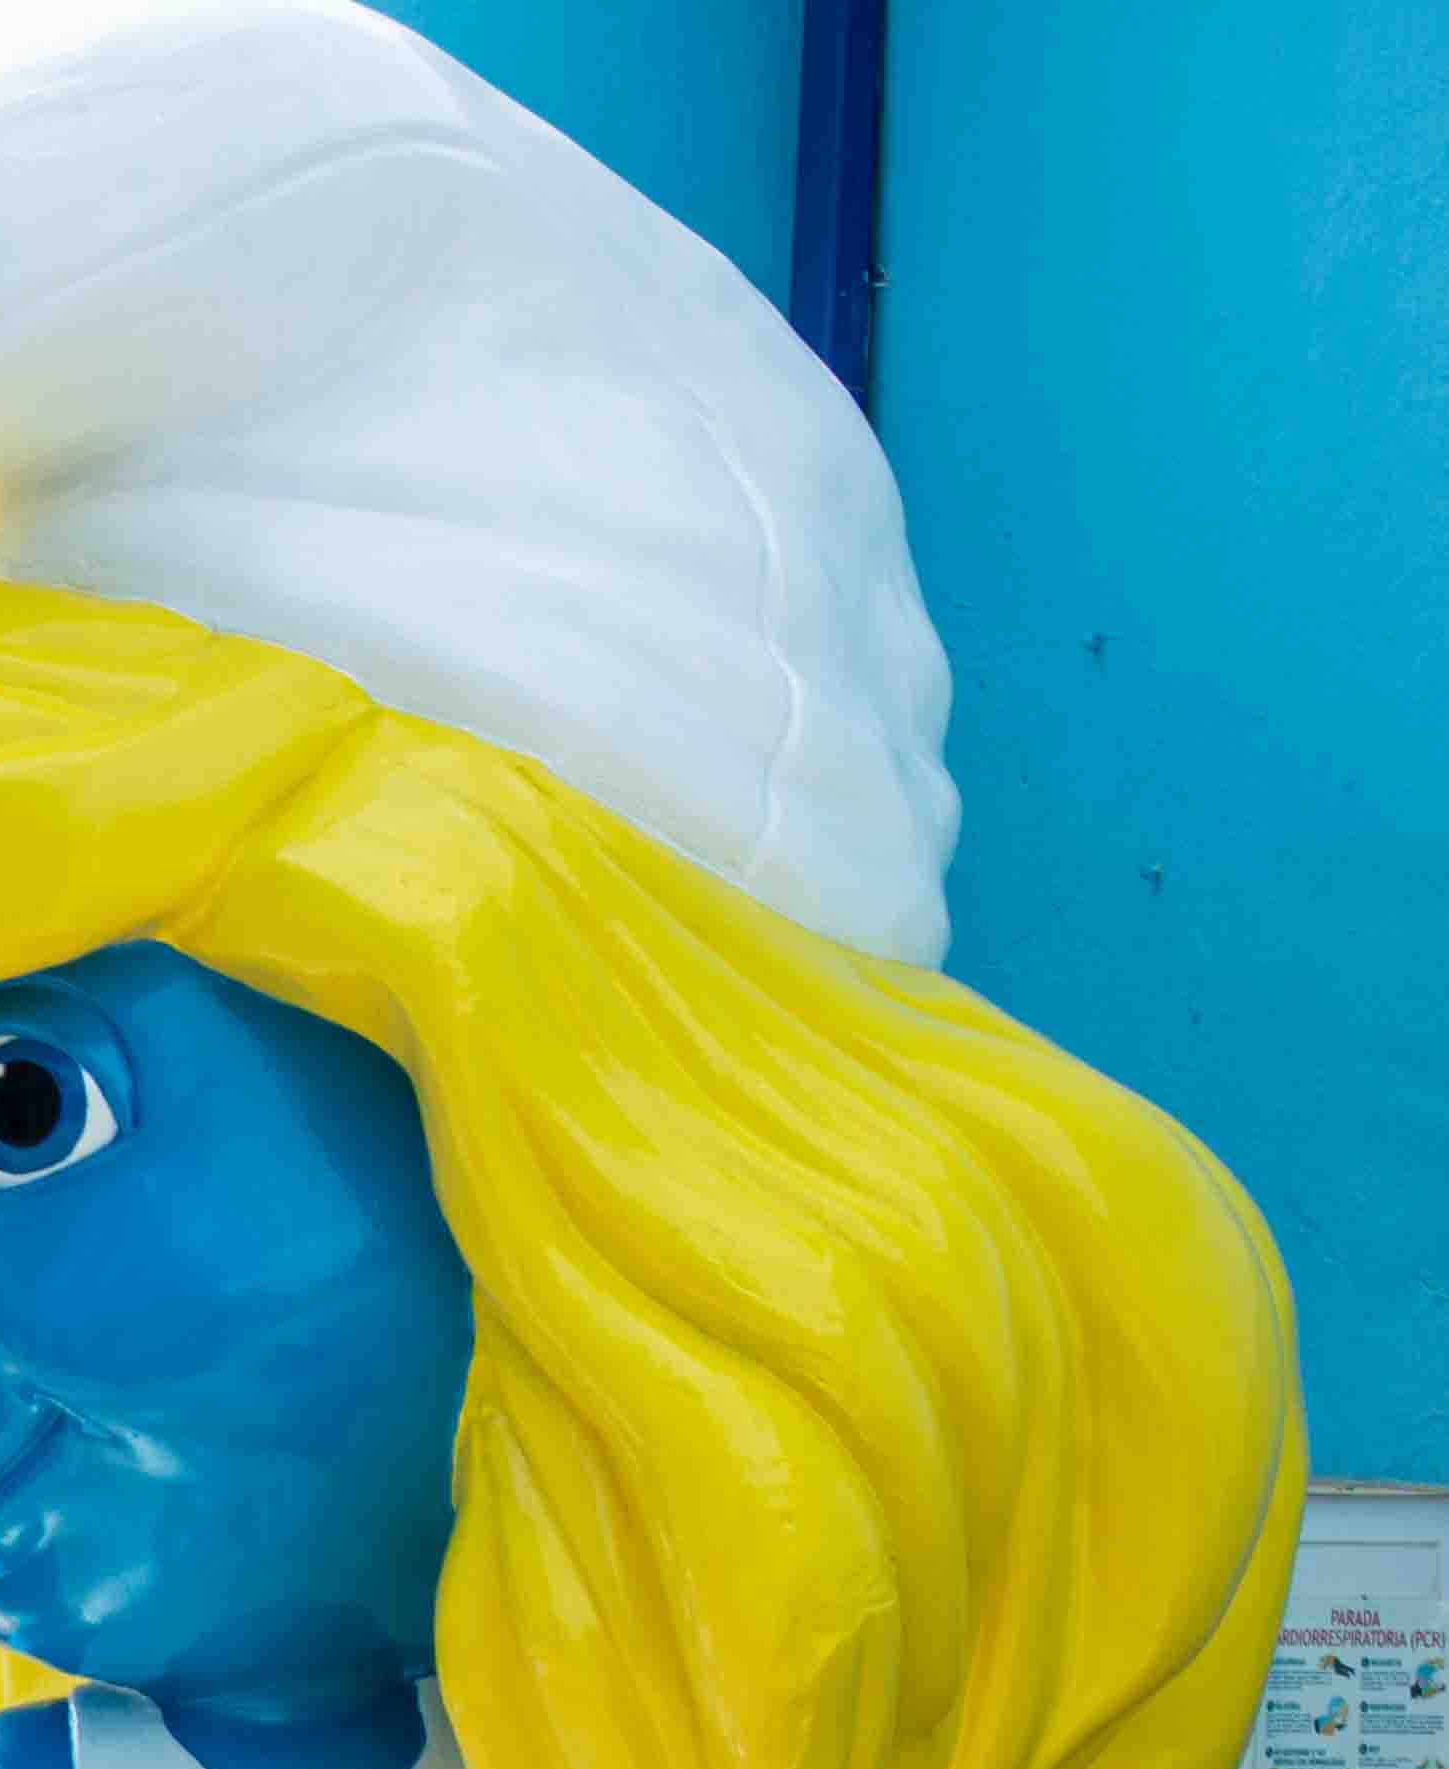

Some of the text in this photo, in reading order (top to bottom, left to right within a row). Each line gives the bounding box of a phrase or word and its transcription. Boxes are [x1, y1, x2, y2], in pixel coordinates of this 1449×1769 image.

[1331, 1609, 1381, 1627] PARADA
[1278, 1628, 1446, 1650] ARDIORRESPIRATORIA (PCR)
